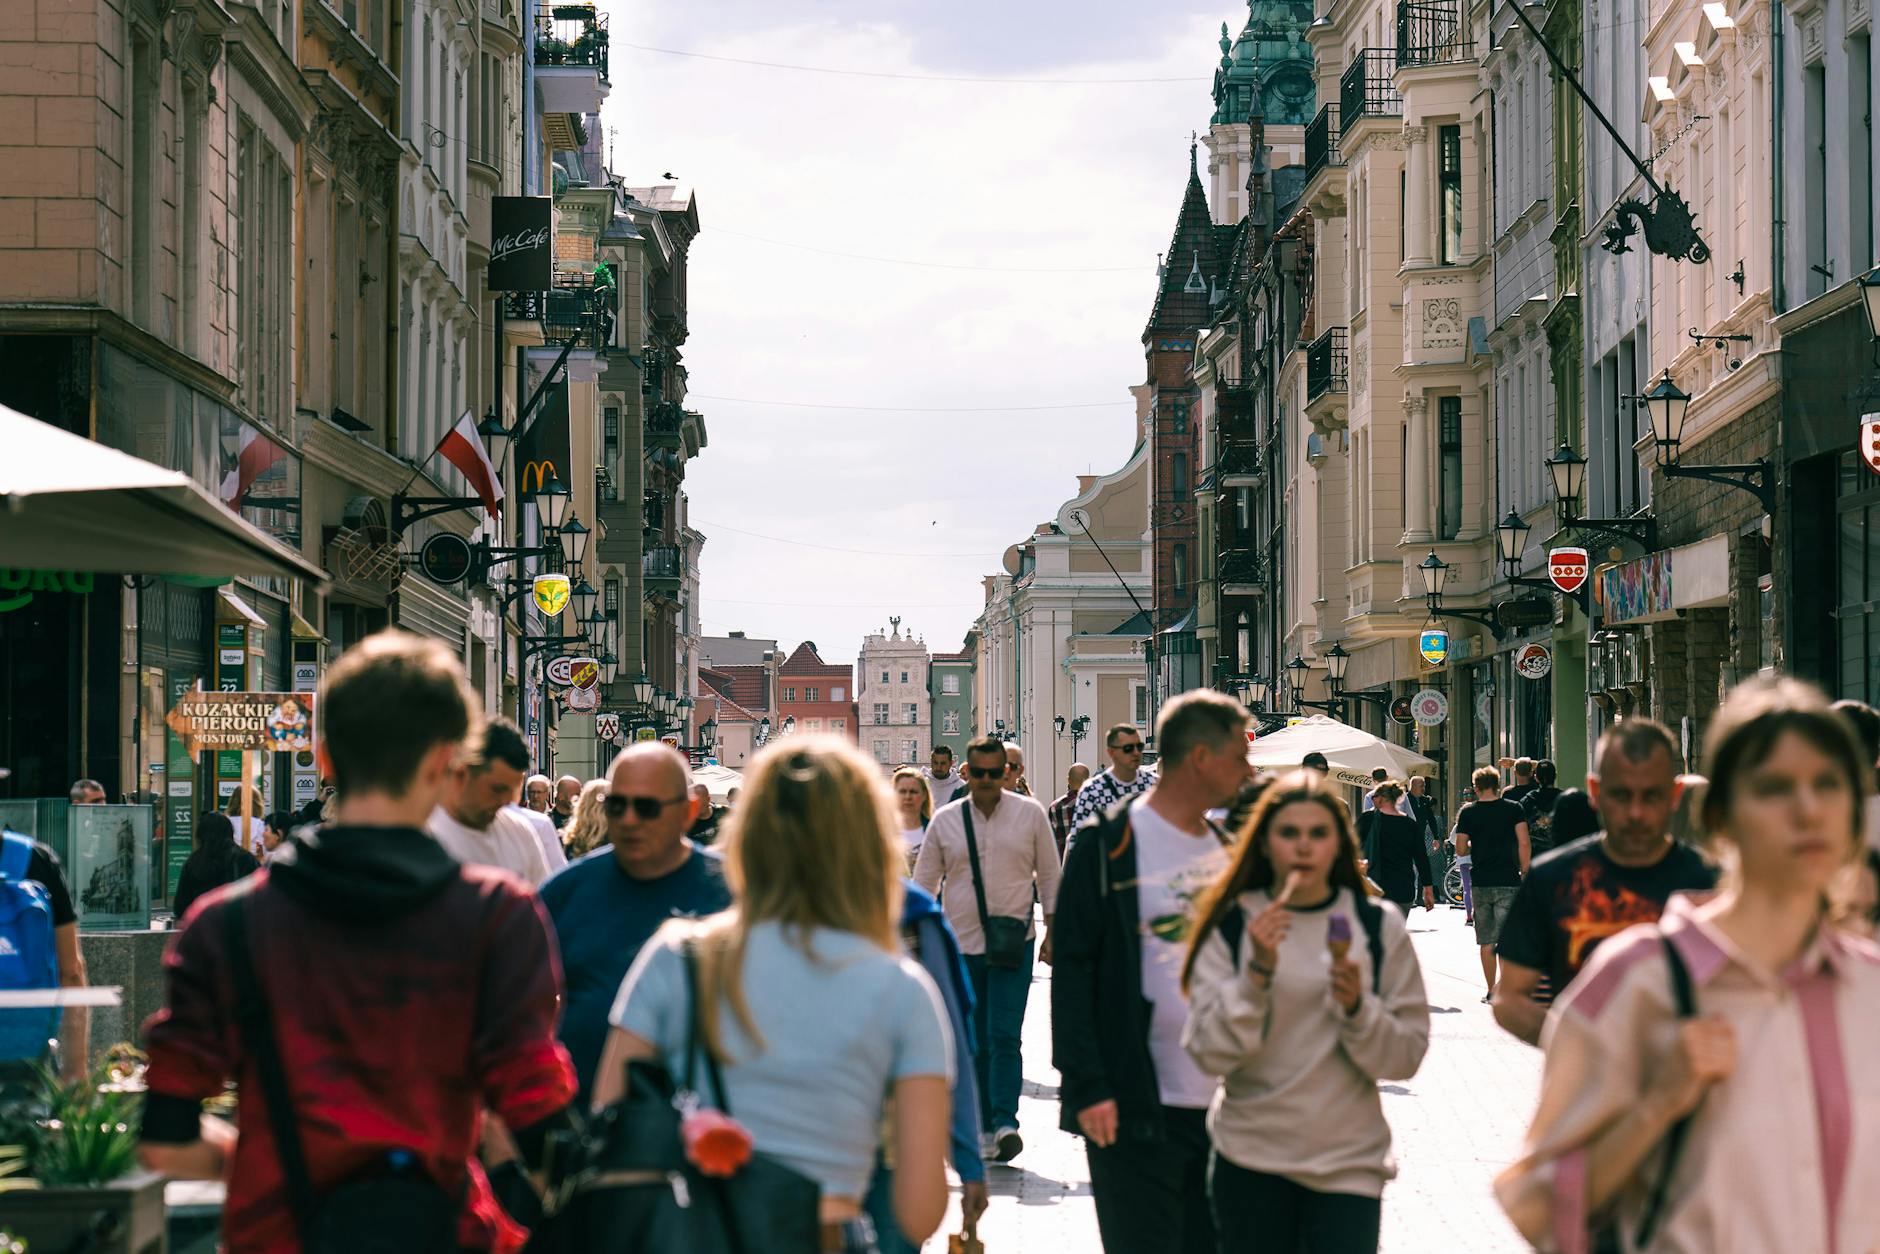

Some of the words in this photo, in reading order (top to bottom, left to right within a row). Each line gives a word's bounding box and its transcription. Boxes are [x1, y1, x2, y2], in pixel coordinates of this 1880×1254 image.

[492, 226, 549, 257] McCafé
[182, 703, 275, 717] KOZACKIE
[191, 717, 265, 730] PIEROGI
[193, 734, 255, 744] MOSTOWA
